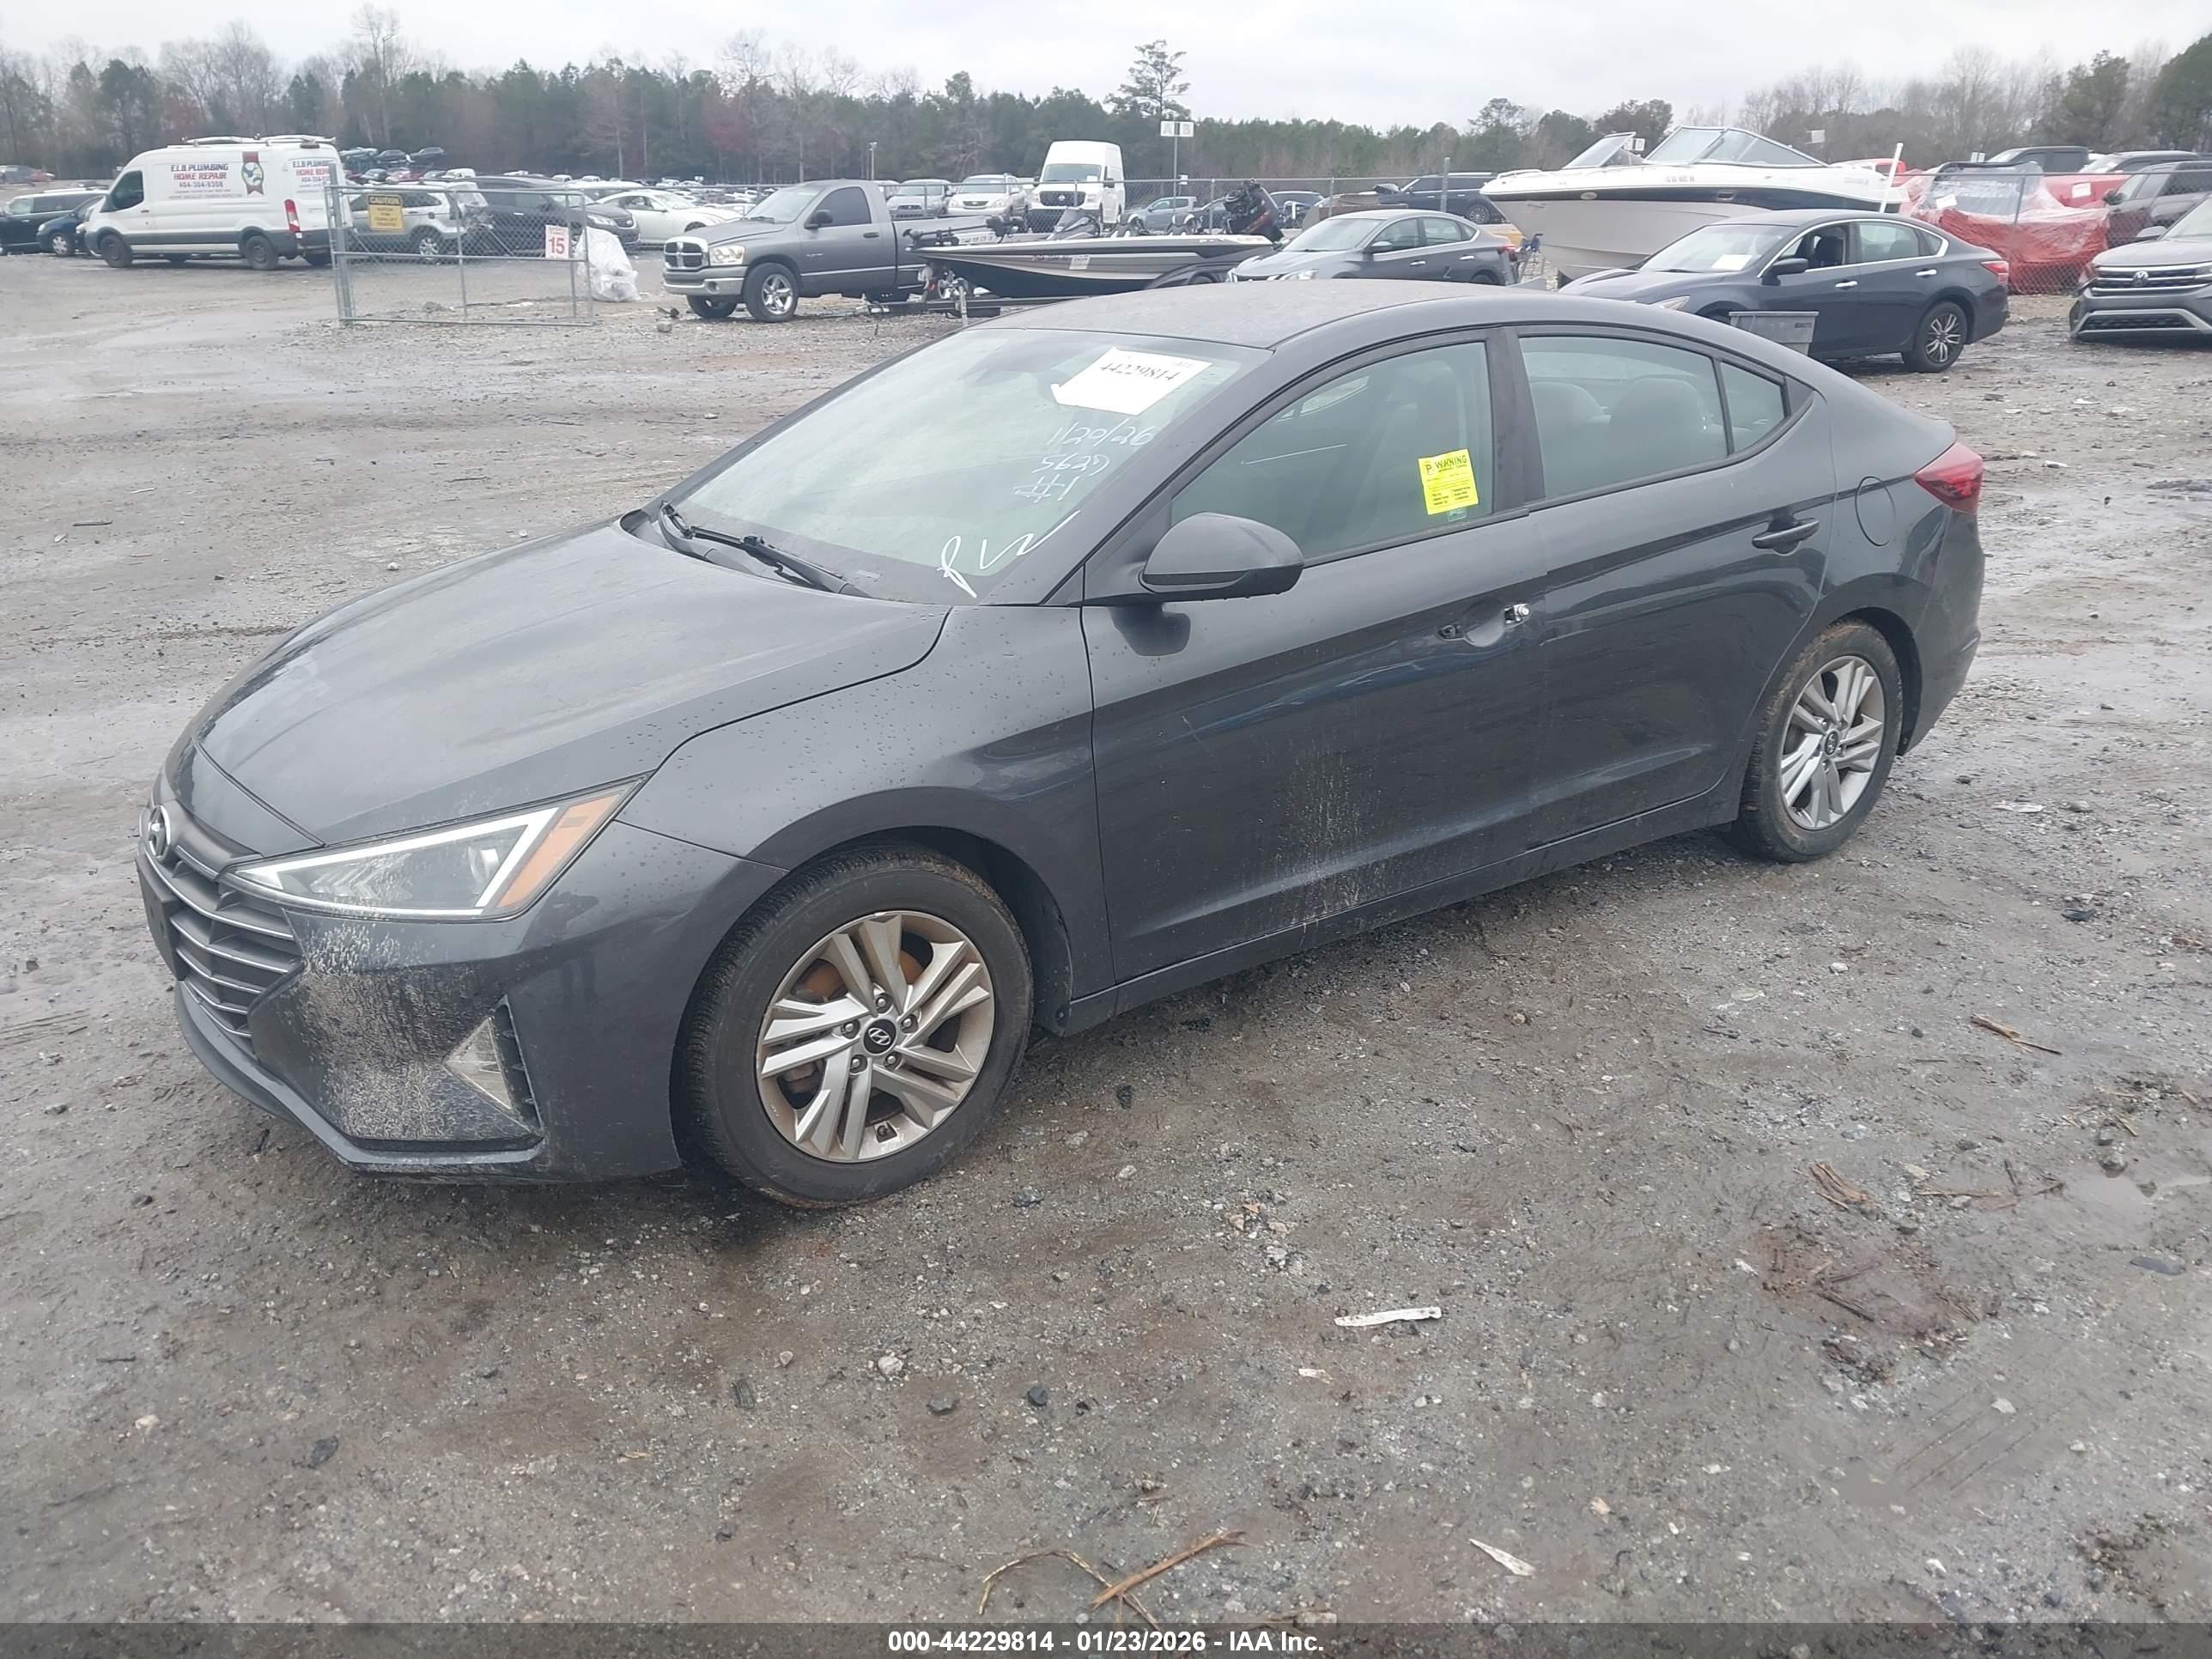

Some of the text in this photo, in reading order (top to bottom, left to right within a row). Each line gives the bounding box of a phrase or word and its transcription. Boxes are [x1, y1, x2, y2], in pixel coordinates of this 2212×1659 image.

[198, 172, 227, 180] REPAIR
[550, 236, 564, 254] 15
[1100, 362, 1180, 381] 44229814
